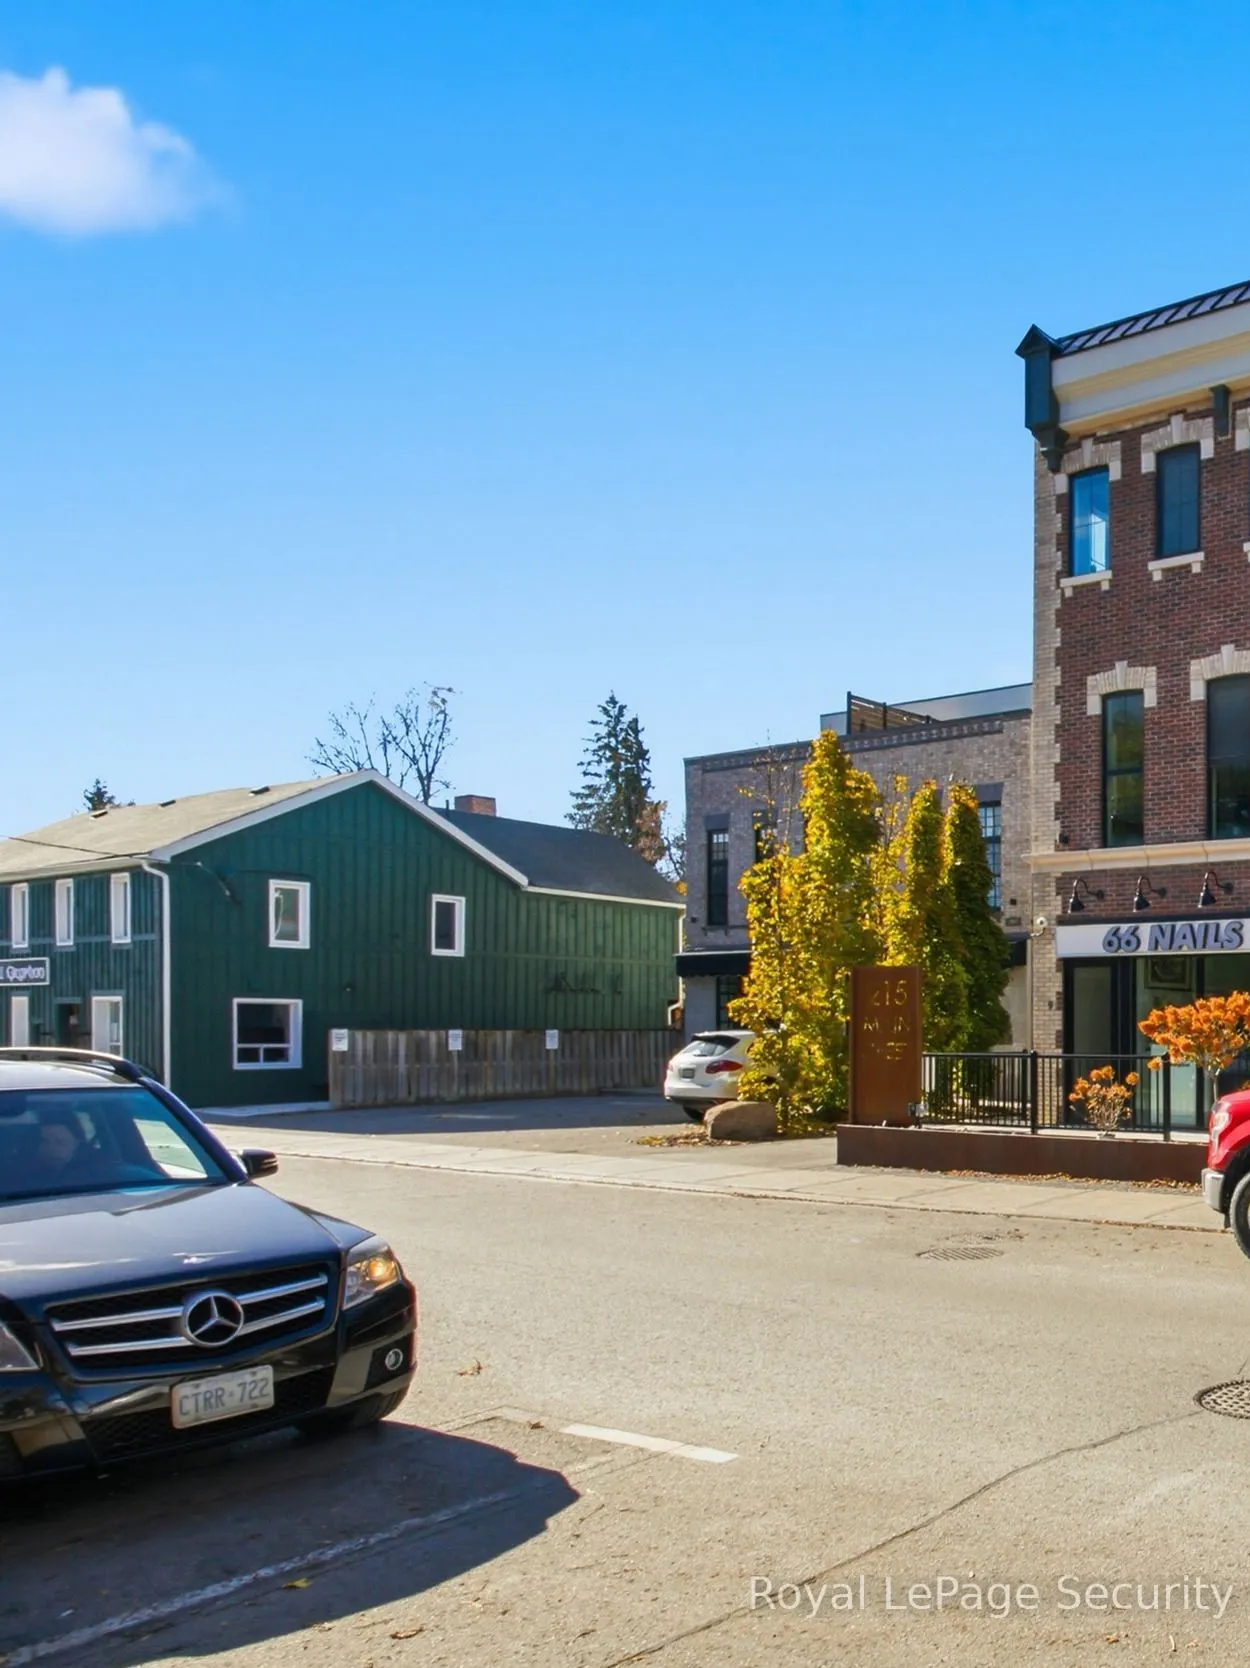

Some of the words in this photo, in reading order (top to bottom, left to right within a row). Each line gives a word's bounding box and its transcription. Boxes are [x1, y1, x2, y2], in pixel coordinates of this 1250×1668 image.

[1102, 925, 1142, 953] 66
[1147, 920, 1245, 951] NAILS
[179, 1387, 225, 1416] CTRR
[236, 1377, 270, 1403] 722
